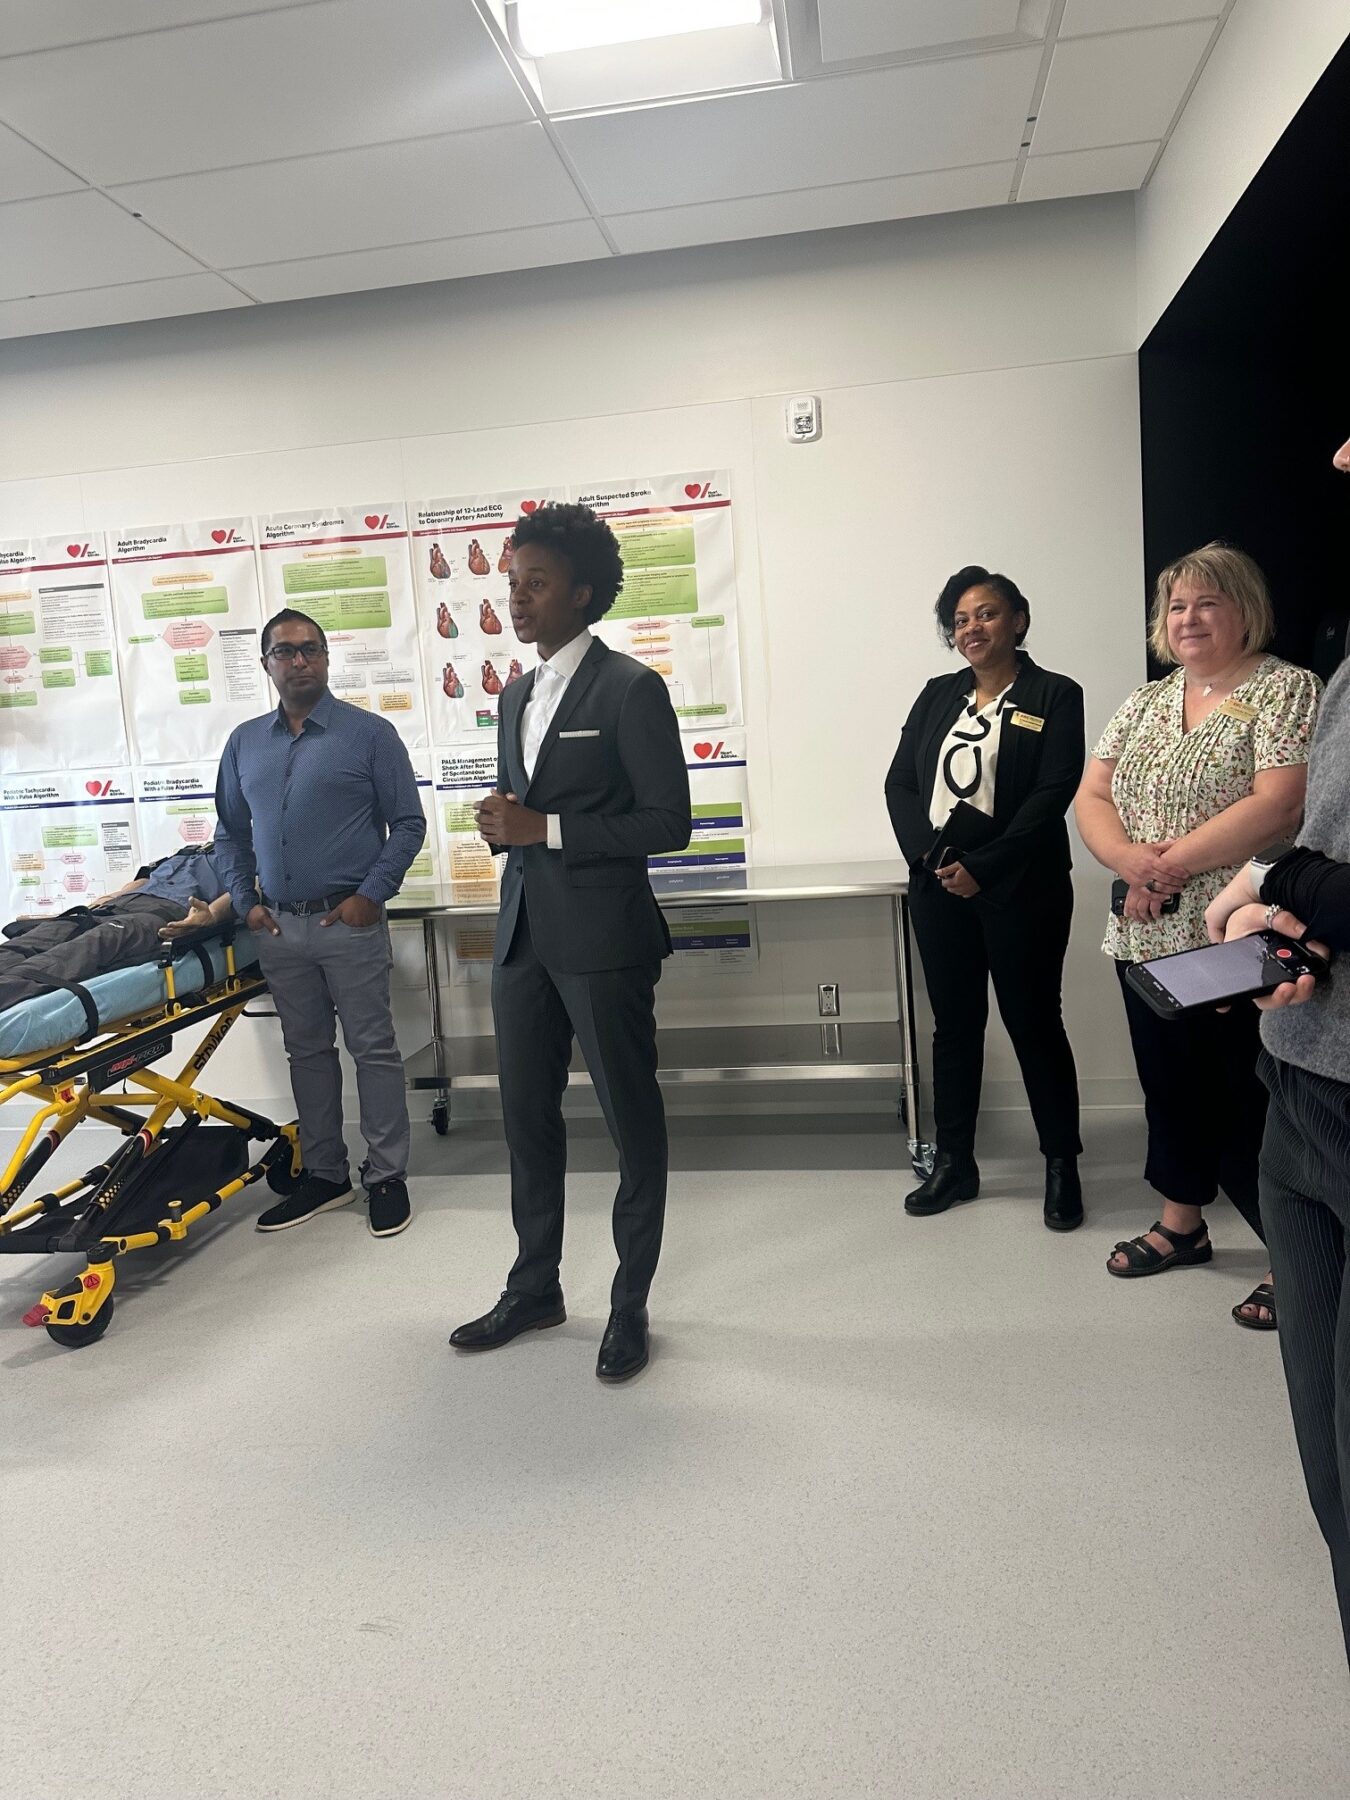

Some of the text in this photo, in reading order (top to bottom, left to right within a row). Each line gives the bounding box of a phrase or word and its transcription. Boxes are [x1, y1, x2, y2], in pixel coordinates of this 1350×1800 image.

[578, 493, 595, 502] Adult
[596, 490, 630, 501] Suspected
[418, 509, 456, 518] Relationship
[464, 506, 488, 514] 12-Lead
[426, 515, 455, 524] Coronary
[455, 513, 475, 522] Artery
[476, 511, 504, 519] Anatomy
[283, 522, 311, 530] Coronary
[266, 530, 295, 538] Algorithm
[117, 537, 167, 547] Adult Bradycardia
[118, 545, 146, 553] Algorithm
[457, 756, 493, 764] Management
[449, 769, 485, 777] Spontaneous
[25, 786, 56, 794] Tachycardia
[33, 792, 60, 800] Algorithm
[194, 1016, 233, 1071] stryker
